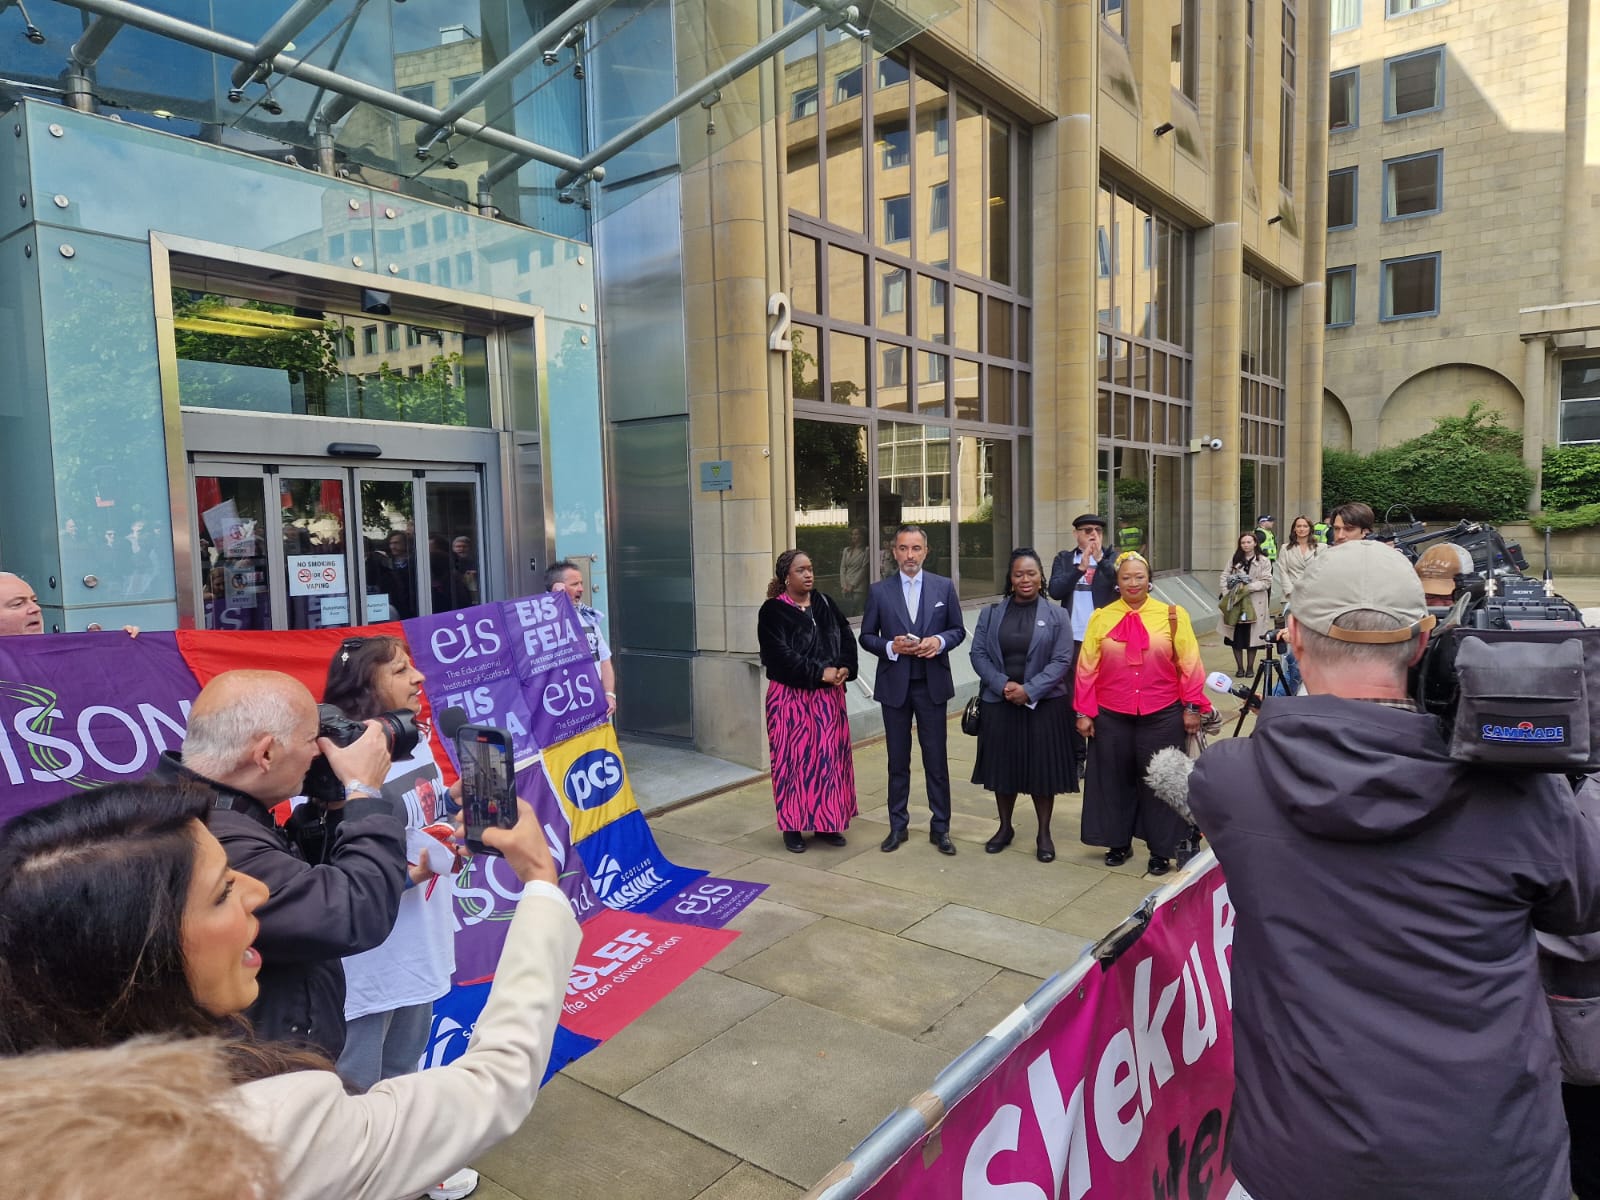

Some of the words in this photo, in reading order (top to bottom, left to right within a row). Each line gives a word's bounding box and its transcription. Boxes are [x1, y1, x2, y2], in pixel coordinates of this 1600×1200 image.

[768, 292, 793, 352] 2
[515, 596, 558, 627] EIS
[431, 613, 501, 664] eis
[523, 618, 578, 656] FELA
[443, 679, 472, 691] Institute
[473, 673, 481, 683] of
[481, 667, 510, 681] Scotland
[446, 670, 460, 679] The
[461, 658, 501, 676] Educational
[543, 669, 595, 717] eis
[1483, 722, 1564, 738] CAMRADE
[570, 756, 620, 811] pcs
[602, 866, 664, 911] NASUWT
[620, 858, 652, 882] SCOTLAND
[675, 884, 733, 914] eis
[563, 1001, 588, 1015] the
[651, 936, 683, 956] union
